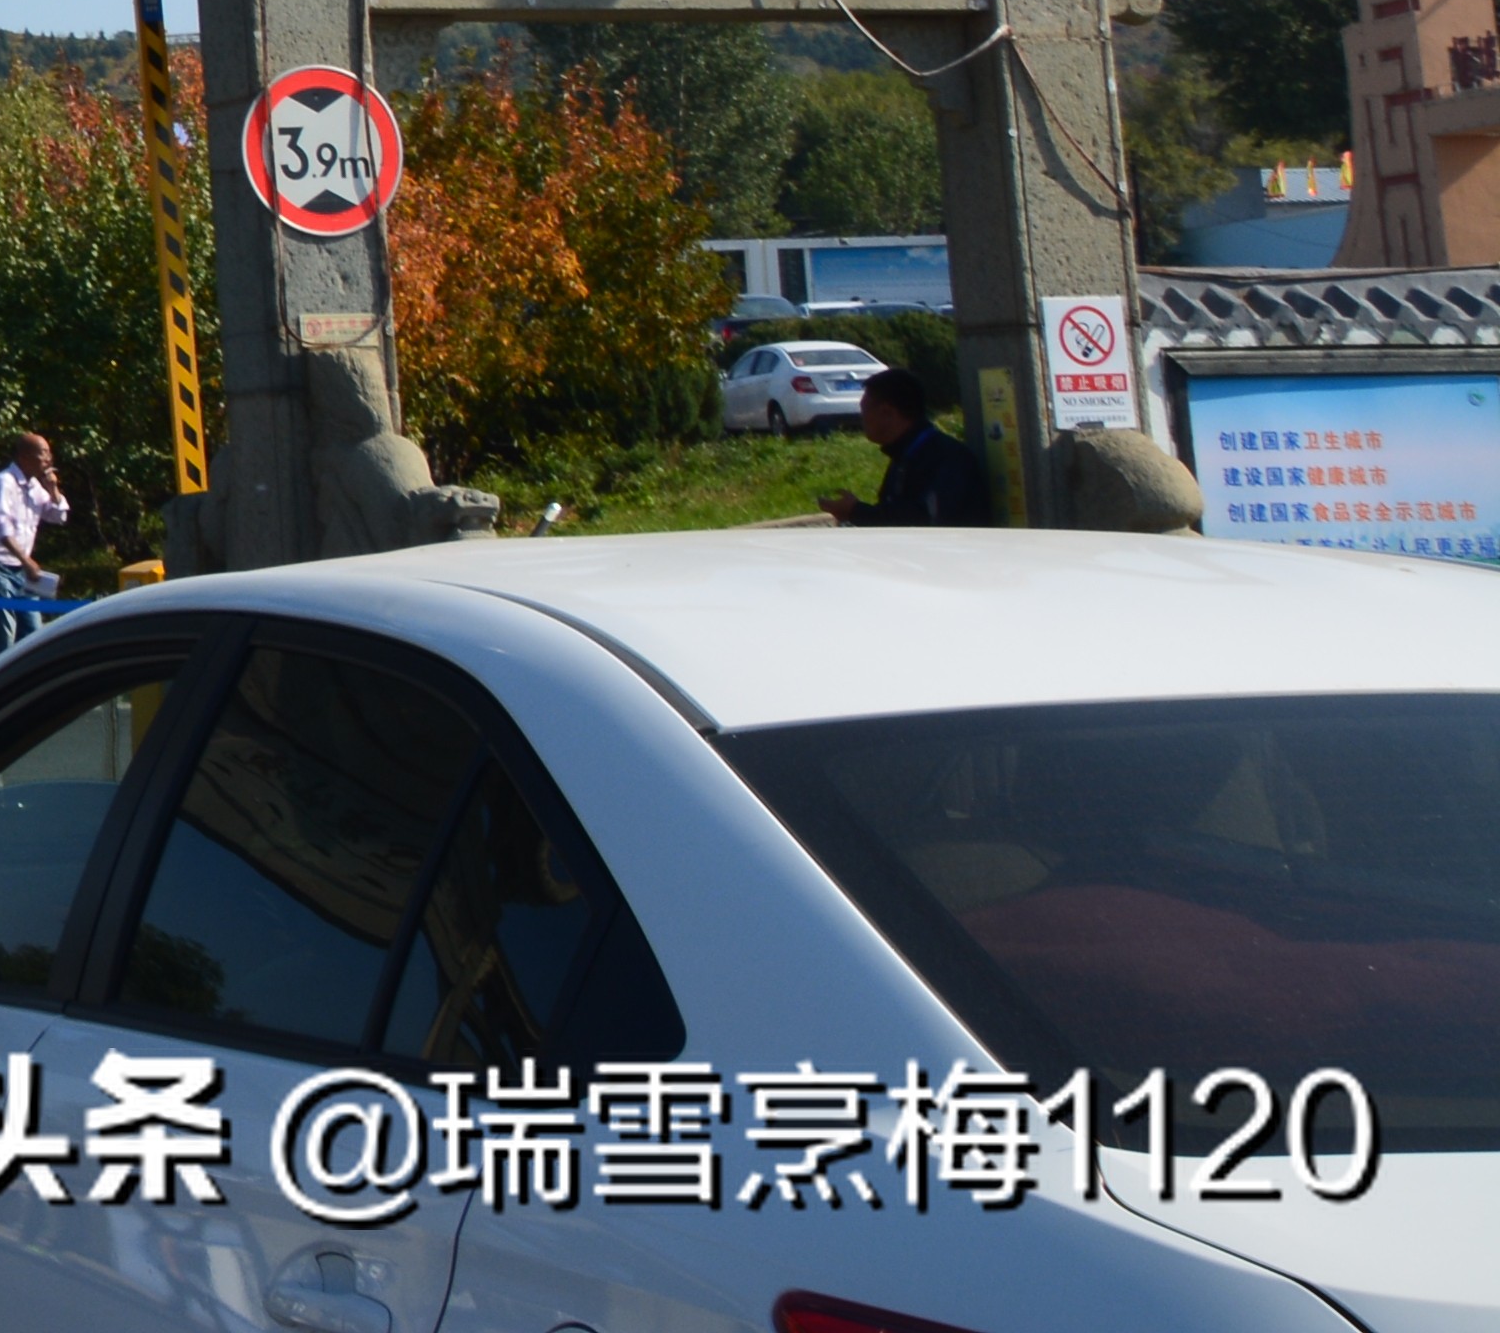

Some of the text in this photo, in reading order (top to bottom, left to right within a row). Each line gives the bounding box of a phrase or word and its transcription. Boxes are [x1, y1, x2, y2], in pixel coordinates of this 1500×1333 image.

[278, 127, 371, 181] 3.9m
[1060, 375, 1125, 390] 禁止吸烟
[1062, 395, 1125, 407] NO SMOKING
[1219, 430, 1384, 452] 创建国家卫生城市
[1223, 466, 1388, 487] 建设国家健康城市
[1227, 501, 1478, 524] 创建国家食品安全示范城市
